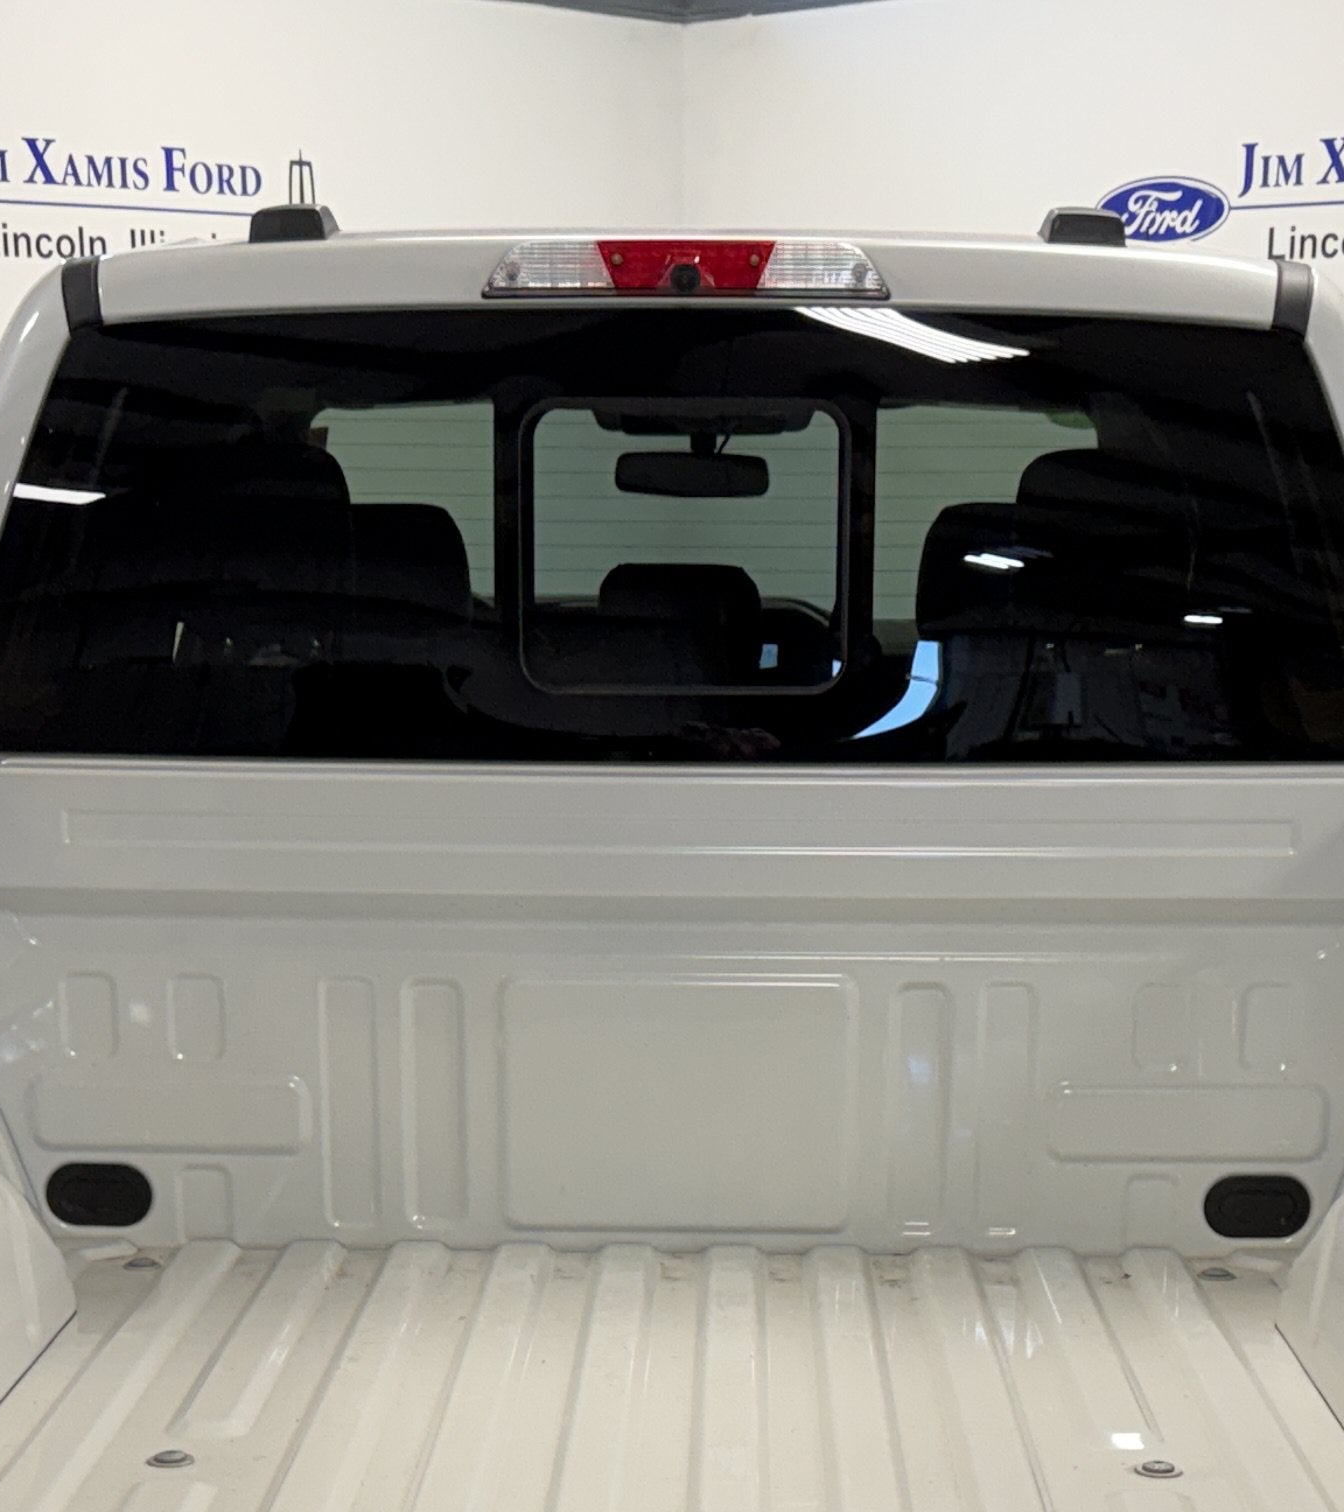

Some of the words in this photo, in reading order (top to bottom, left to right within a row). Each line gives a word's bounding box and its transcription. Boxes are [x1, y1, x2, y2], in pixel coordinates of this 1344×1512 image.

[22, 137, 149, 190] XAMIS
[161, 146, 262, 197] FORD
[1122, 189, 1203, 236] Ford
[1238, 142, 1304, 198] JIM
